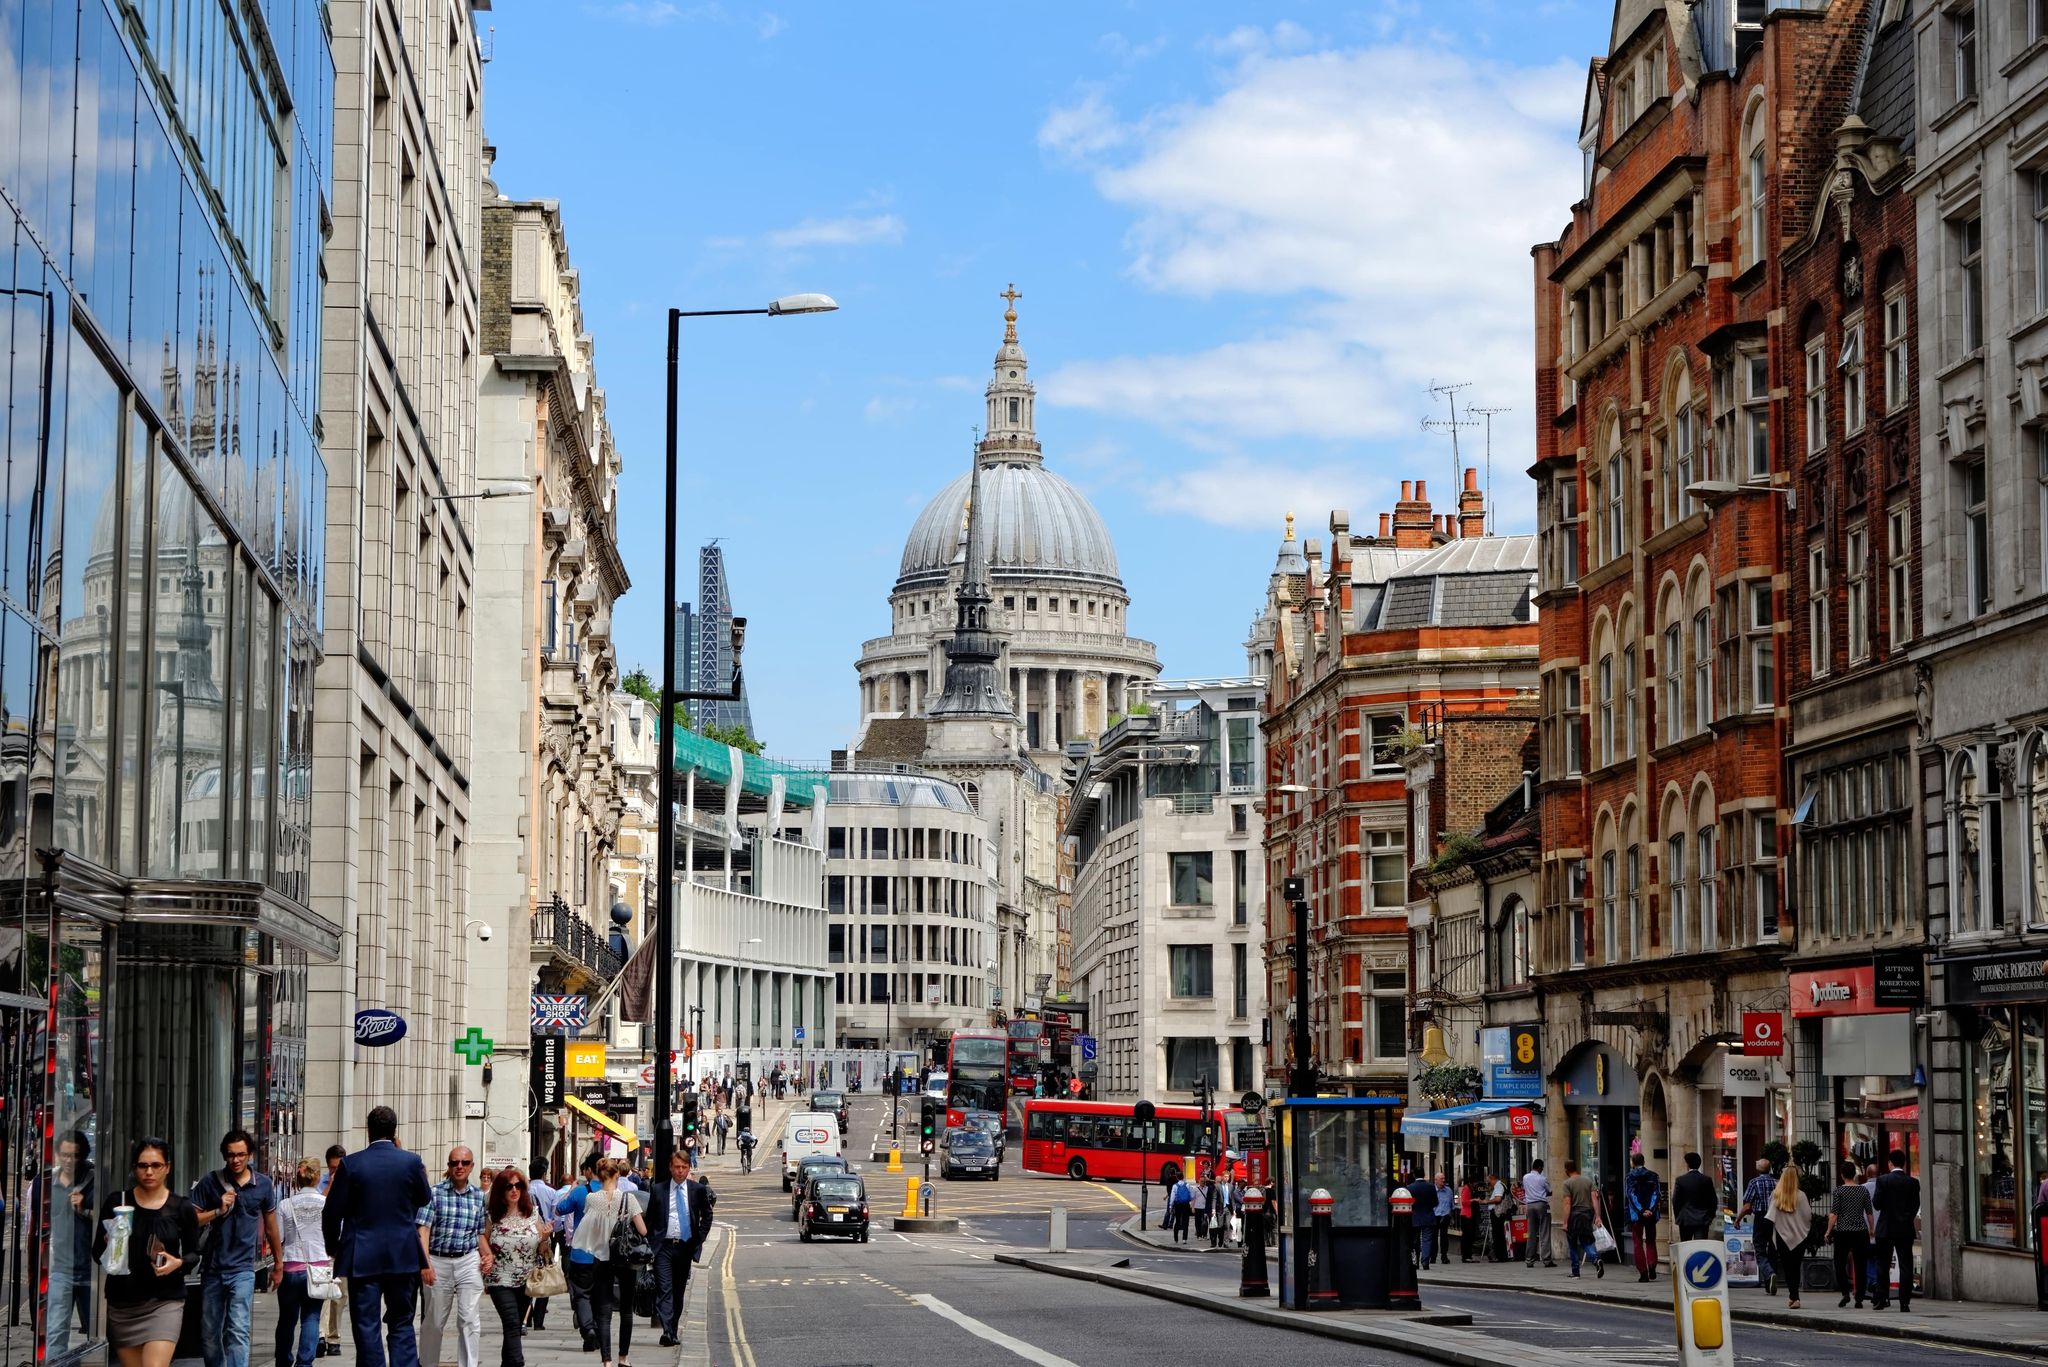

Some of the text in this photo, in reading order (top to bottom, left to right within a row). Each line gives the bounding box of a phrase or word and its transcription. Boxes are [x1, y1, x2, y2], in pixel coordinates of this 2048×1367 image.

[1972, 965, 2003, 981] SUTTONS
[2004, 963, 2009, 978] &
[356, 1016, 397, 1039] Boots
[575, 1055, 600, 1064] EAT.
[1084, 1044, 1095, 1059] S
[545, 1039, 557, 1104] wagamama
[1242, 1098, 1262, 1107] pod
